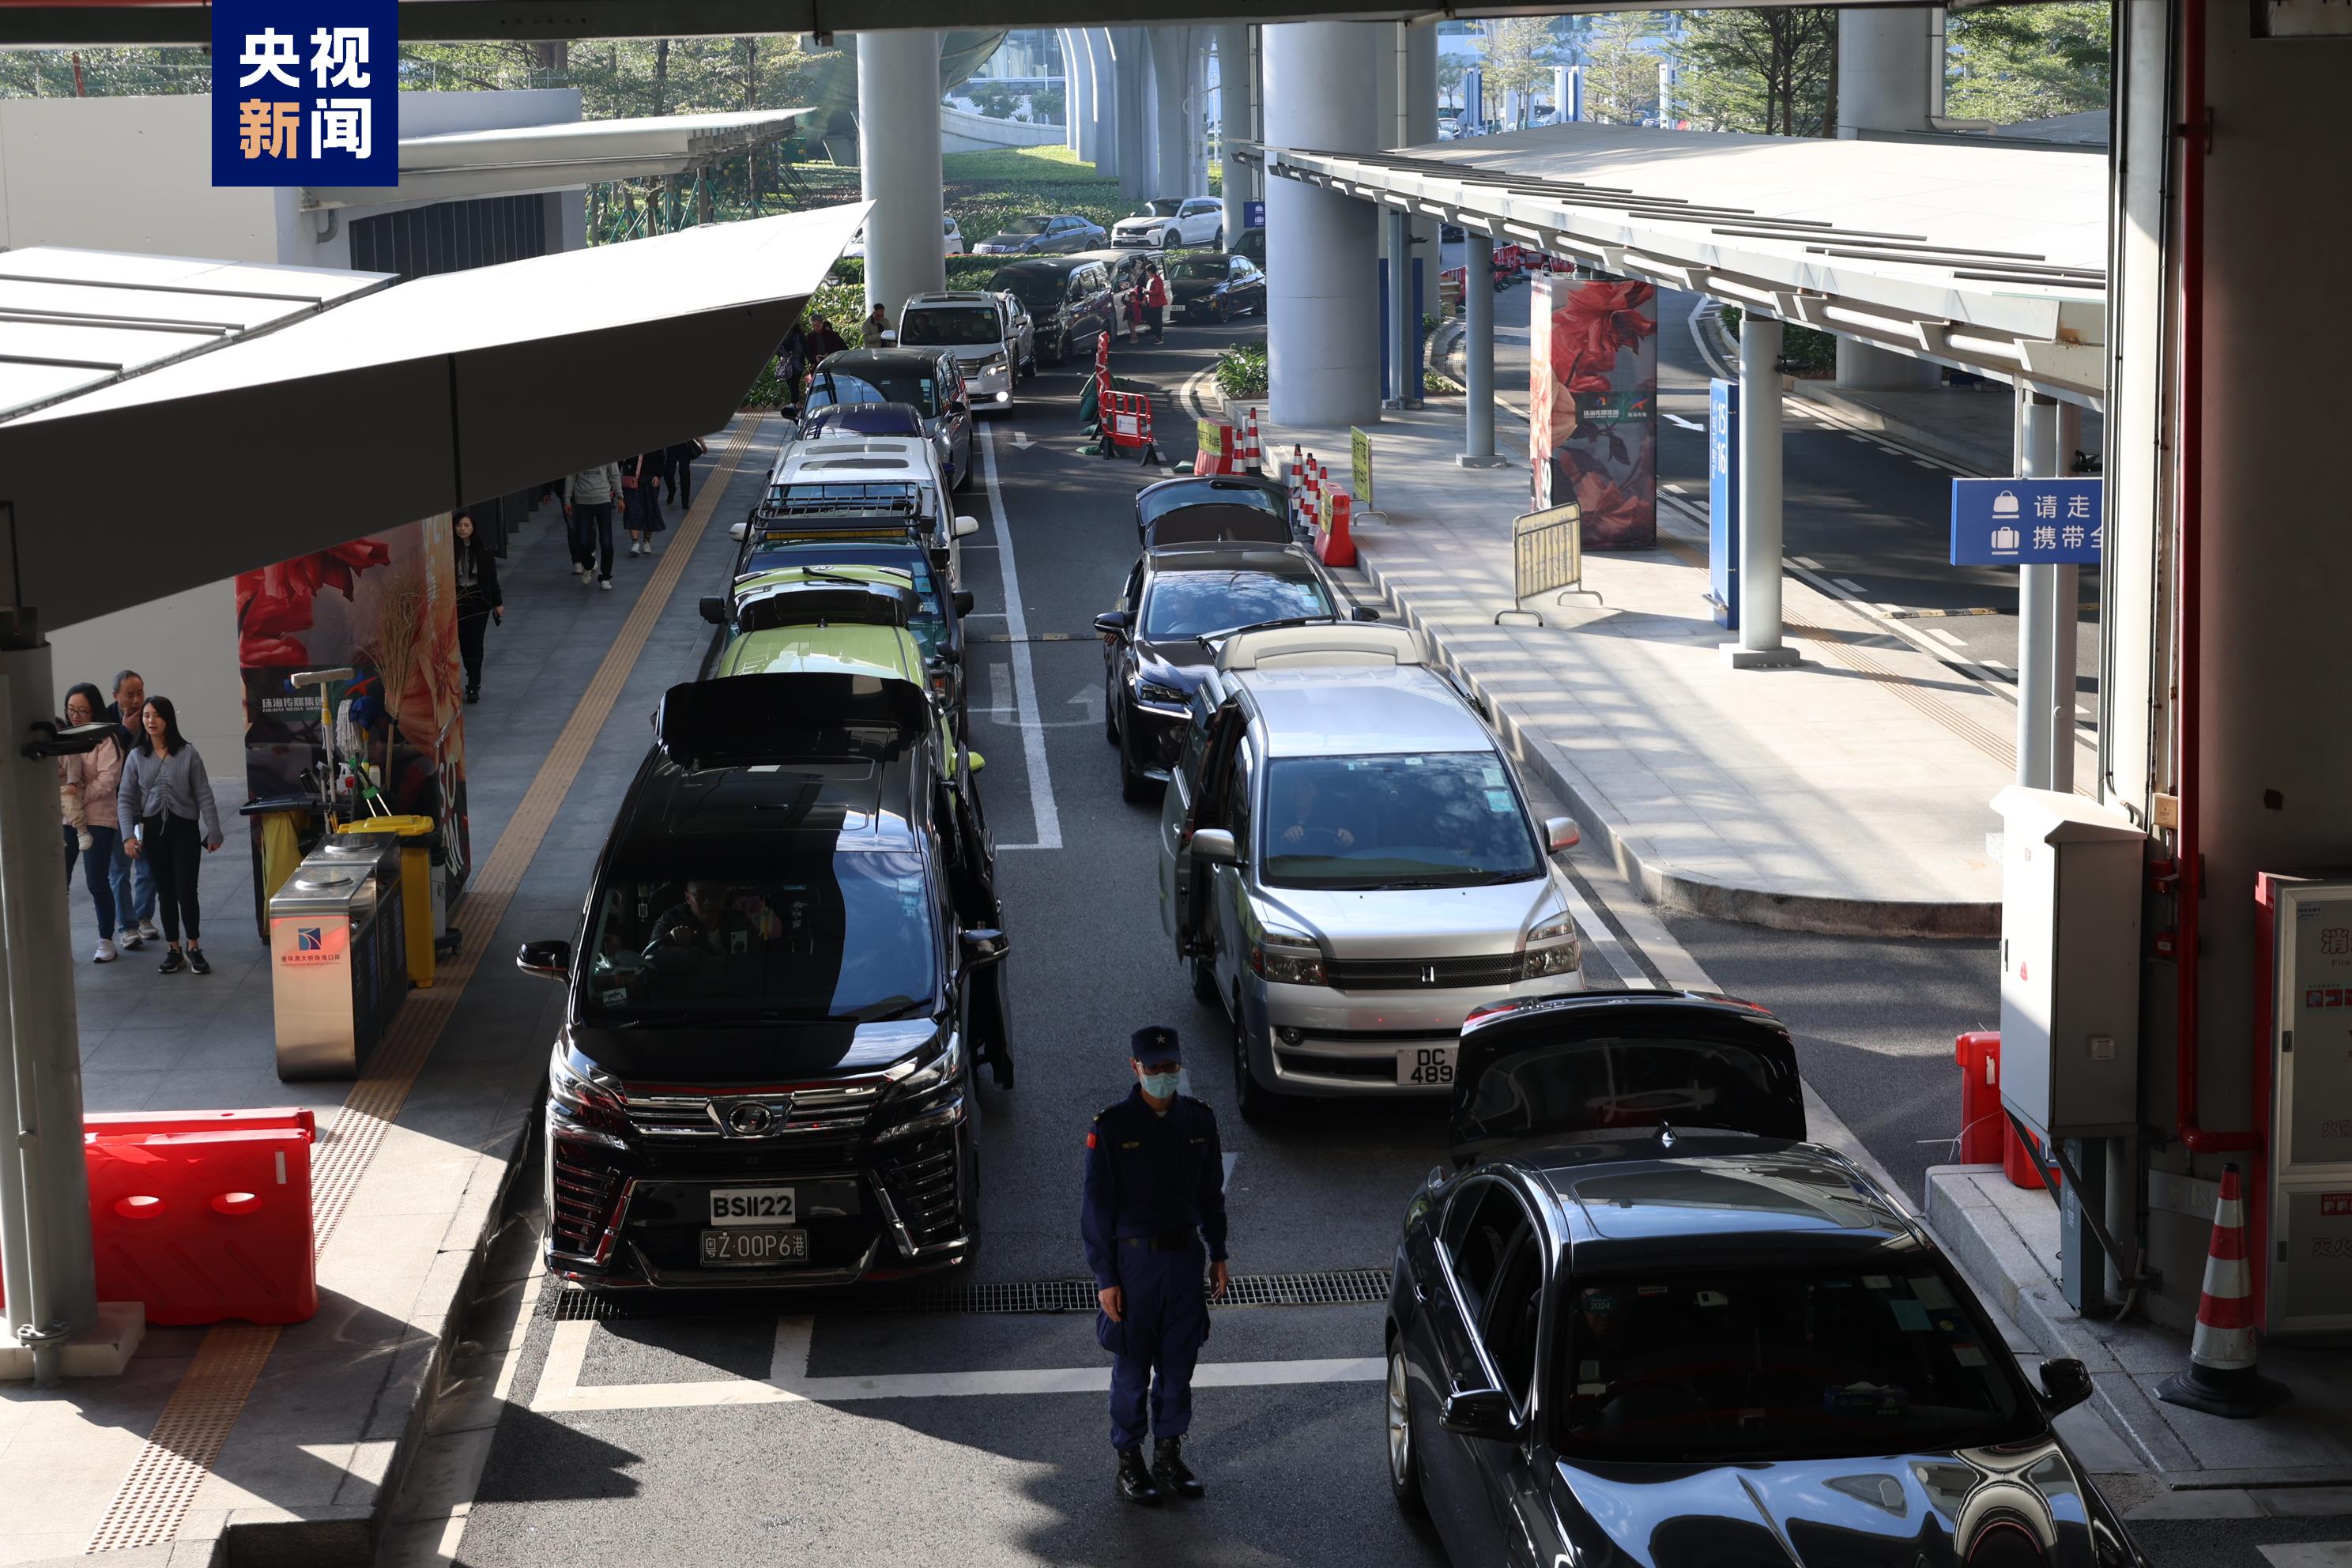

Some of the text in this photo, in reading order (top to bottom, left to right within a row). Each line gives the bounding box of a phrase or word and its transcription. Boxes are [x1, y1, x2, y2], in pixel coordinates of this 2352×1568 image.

[2321, 928, 2352, 955] 消
[1417, 1048, 1446, 1066] DC
[1410, 1065, 1453, 1083] 489
